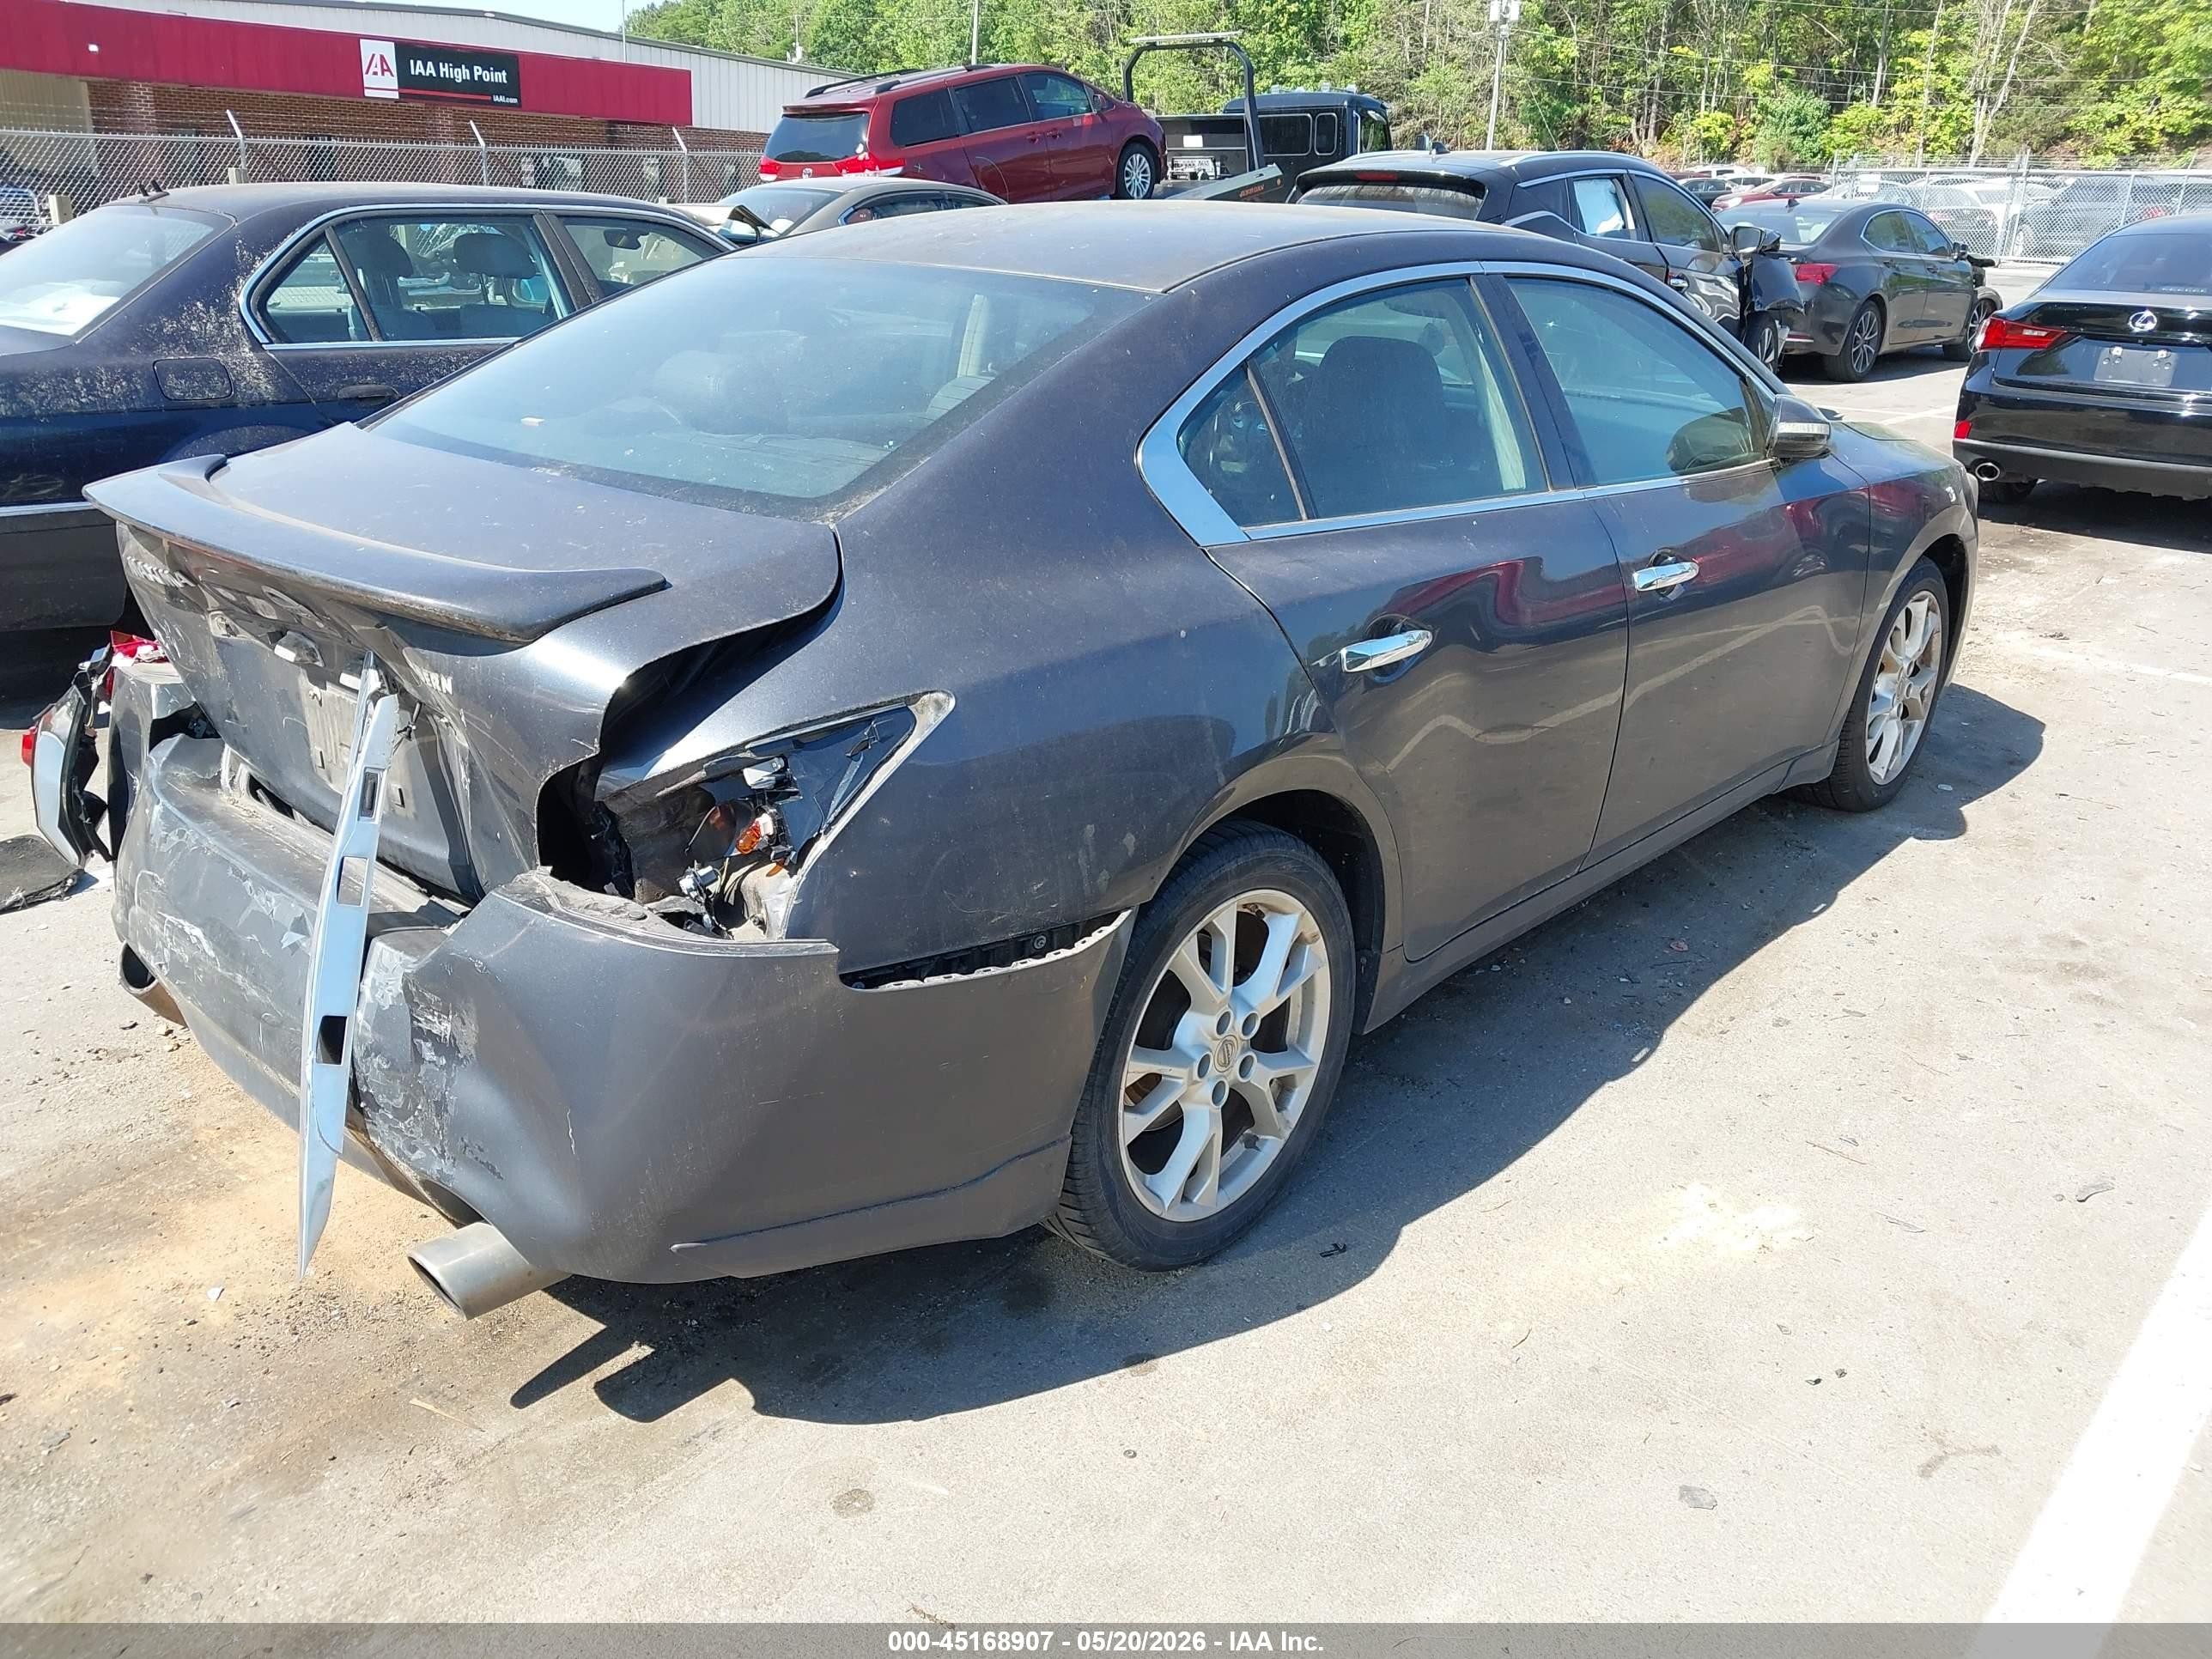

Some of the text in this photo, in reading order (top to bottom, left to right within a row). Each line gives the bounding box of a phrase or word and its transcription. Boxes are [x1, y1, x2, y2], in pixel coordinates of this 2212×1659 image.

[410, 59, 508, 83] IAA High Point
